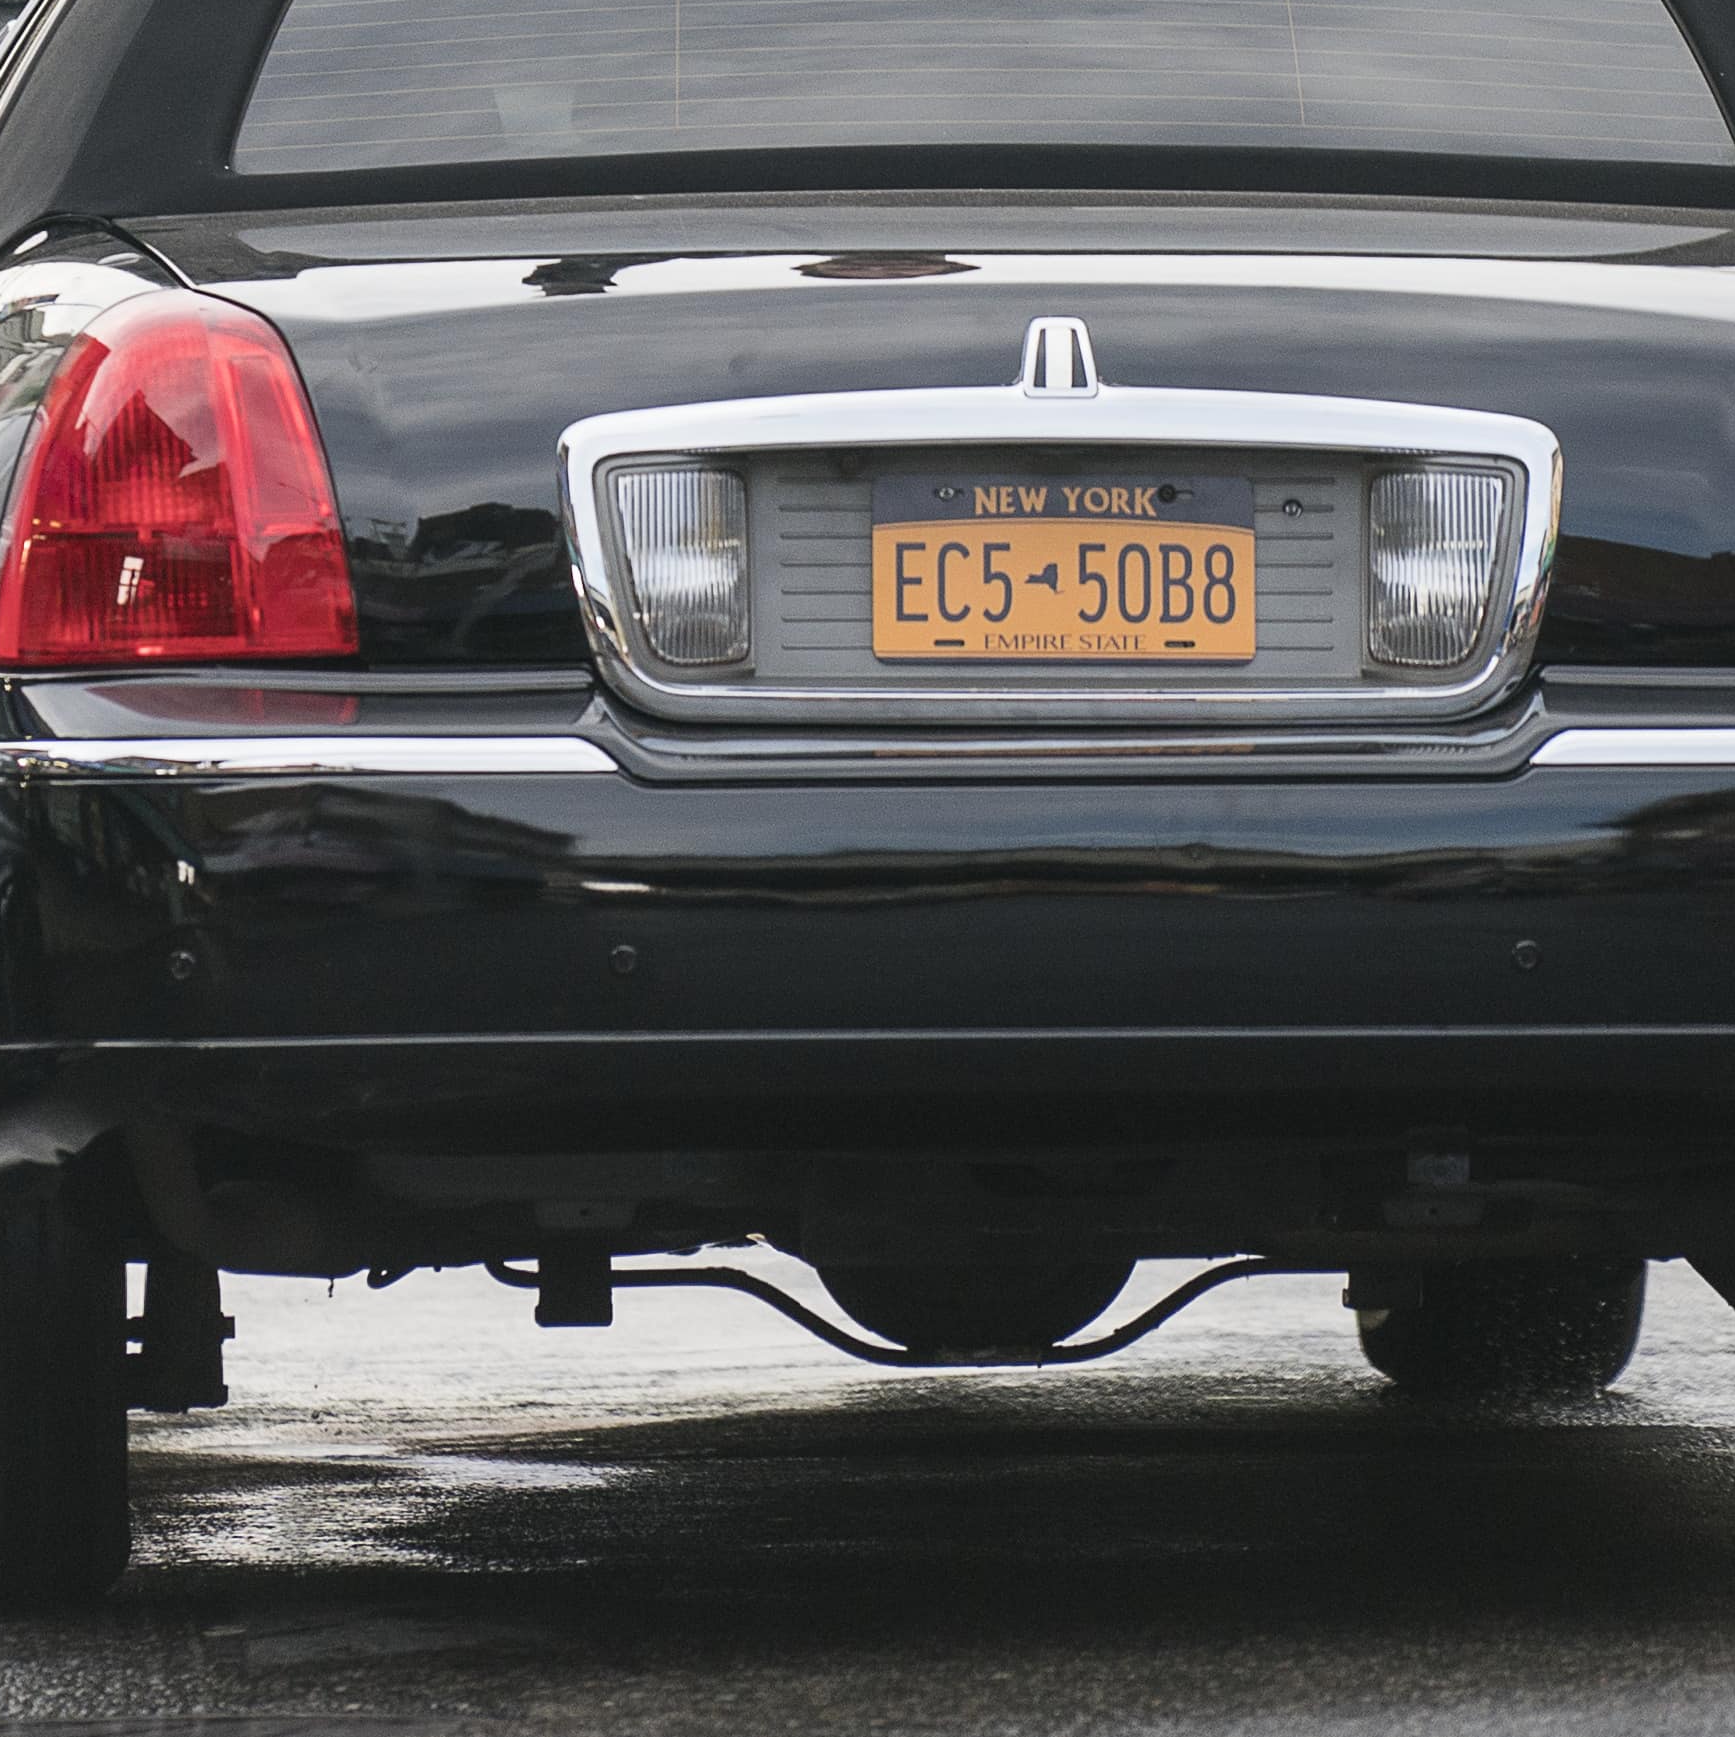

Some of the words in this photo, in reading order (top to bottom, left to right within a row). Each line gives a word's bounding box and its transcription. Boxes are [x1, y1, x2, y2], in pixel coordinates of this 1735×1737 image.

[974, 485, 1048, 515] NEW
[1061, 486, 1158, 517] YORK
[983, 633, 1075, 651] EMPIRE
[1079, 634, 1147, 652] STATE
